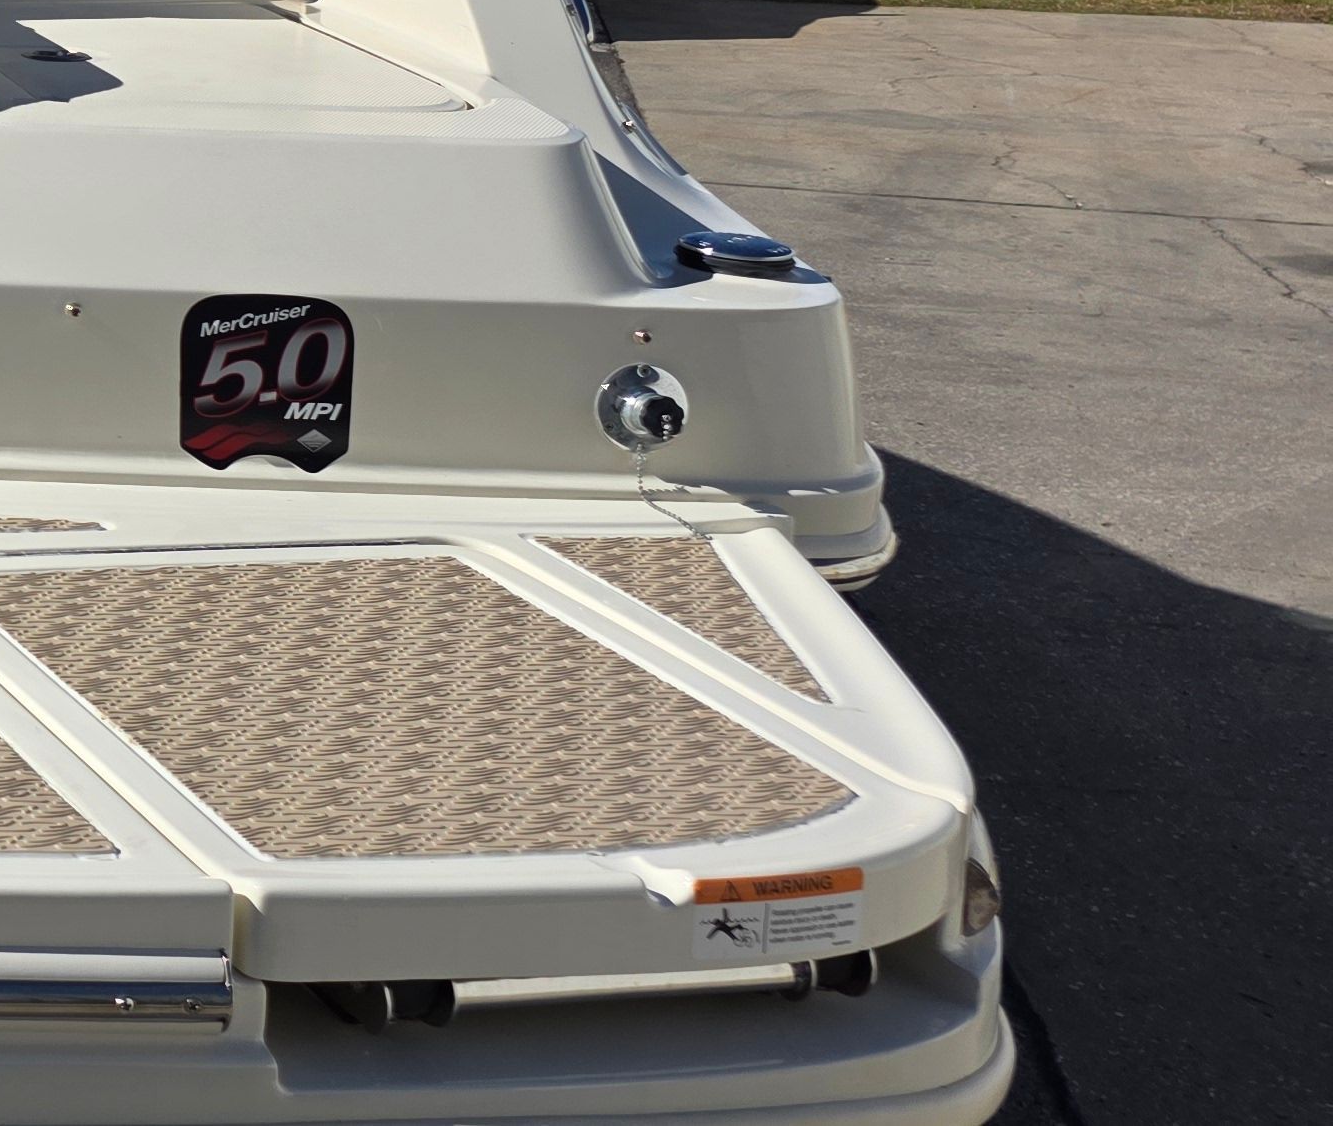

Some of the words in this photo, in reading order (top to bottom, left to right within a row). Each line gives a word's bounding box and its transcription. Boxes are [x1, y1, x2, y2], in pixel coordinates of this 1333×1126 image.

[200, 304, 310, 337] MerCruiser
[194, 317, 347, 418] 5.0
[283, 402, 343, 420] MPI
[753, 876, 833, 897] WARNING
